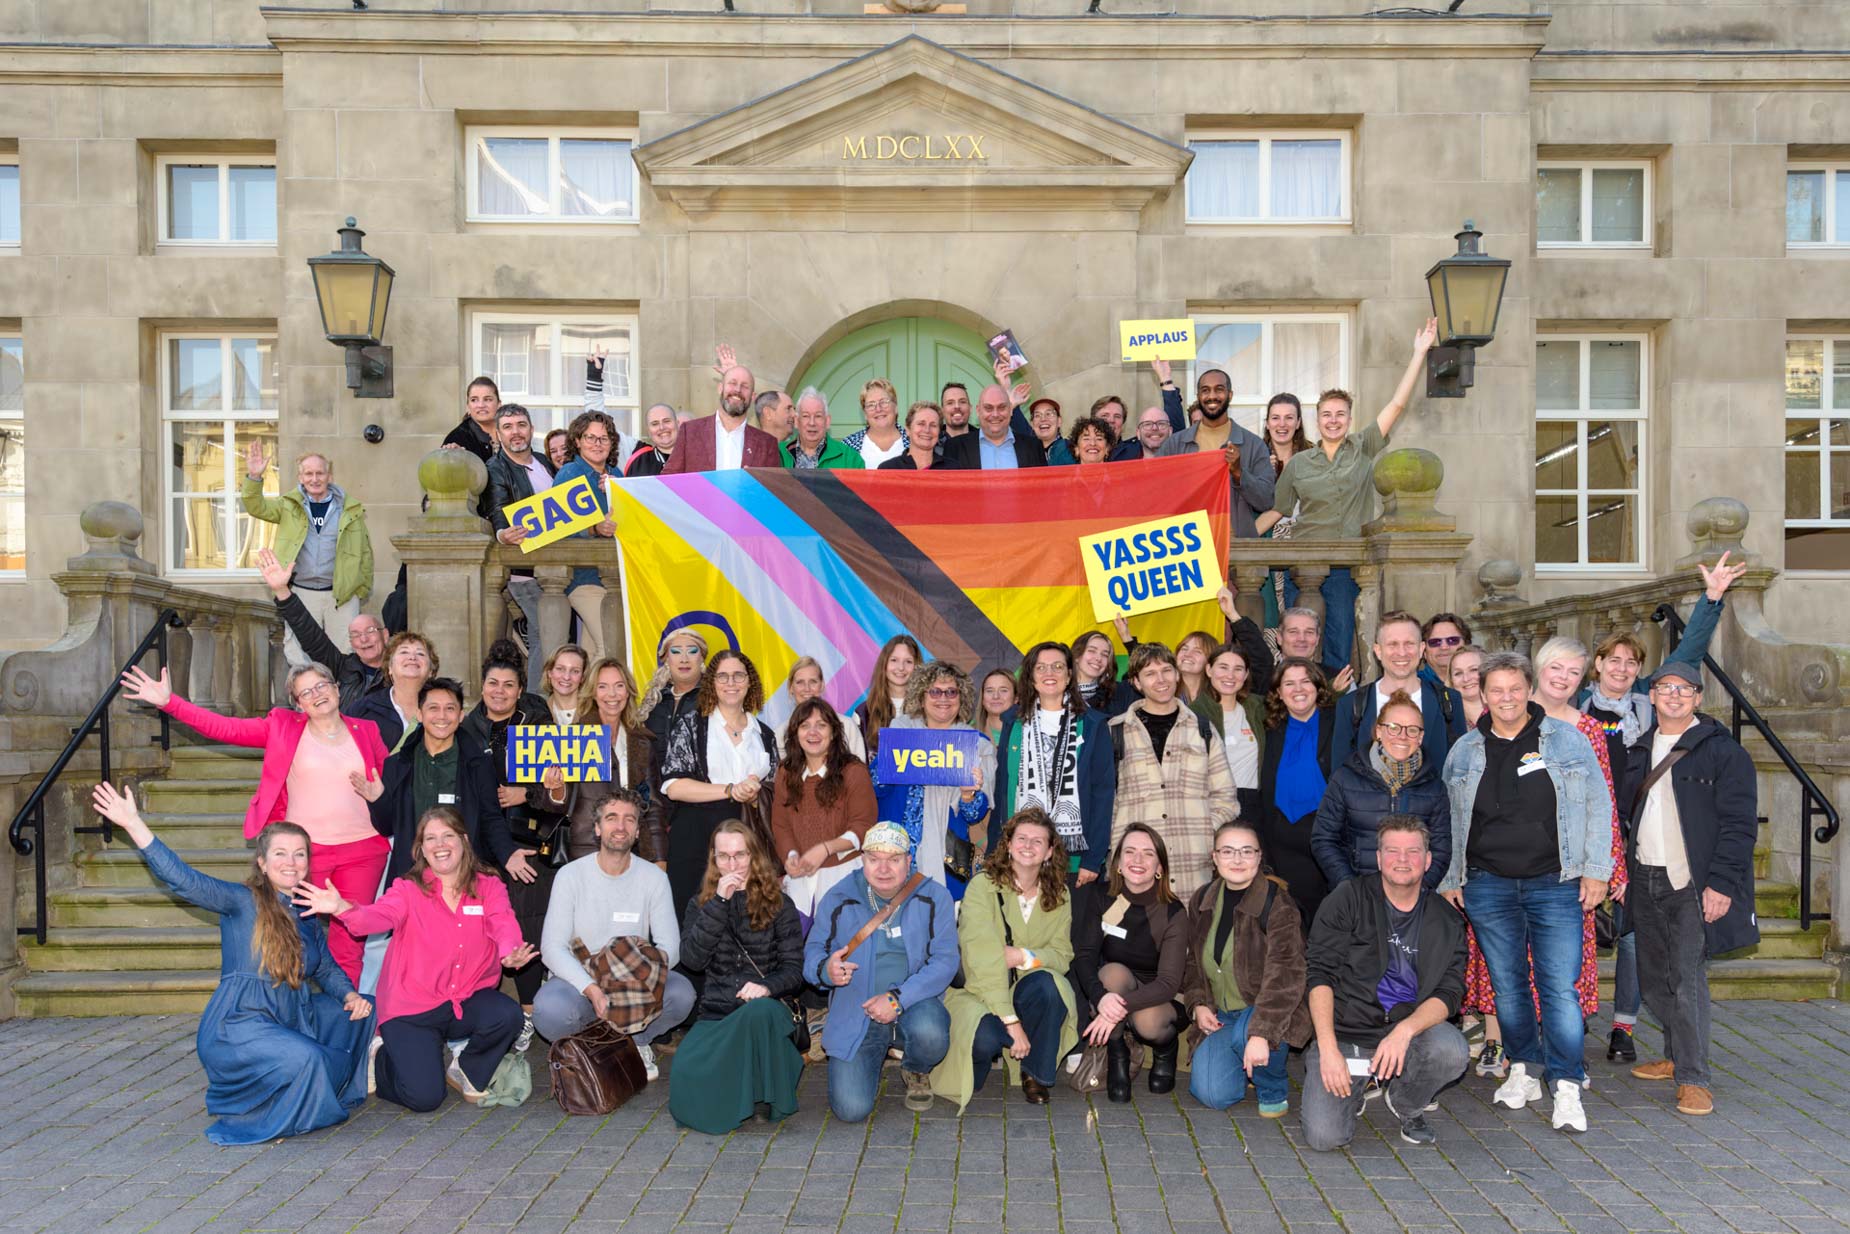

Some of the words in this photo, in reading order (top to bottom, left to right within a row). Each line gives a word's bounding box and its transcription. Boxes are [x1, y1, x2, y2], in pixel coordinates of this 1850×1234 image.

[1129, 330, 1188, 347] APPLAUS
[512, 483, 598, 539] GAG
[1092, 522, 1202, 571] YASSSS
[1107, 558, 1204, 611] QUEEN
[515, 740, 604, 764] HAHA
[892, 743, 964, 773] yeah
[1032, 721, 1040, 753] REMEMBER
[1036, 754, 1044, 789] STONEWALL
